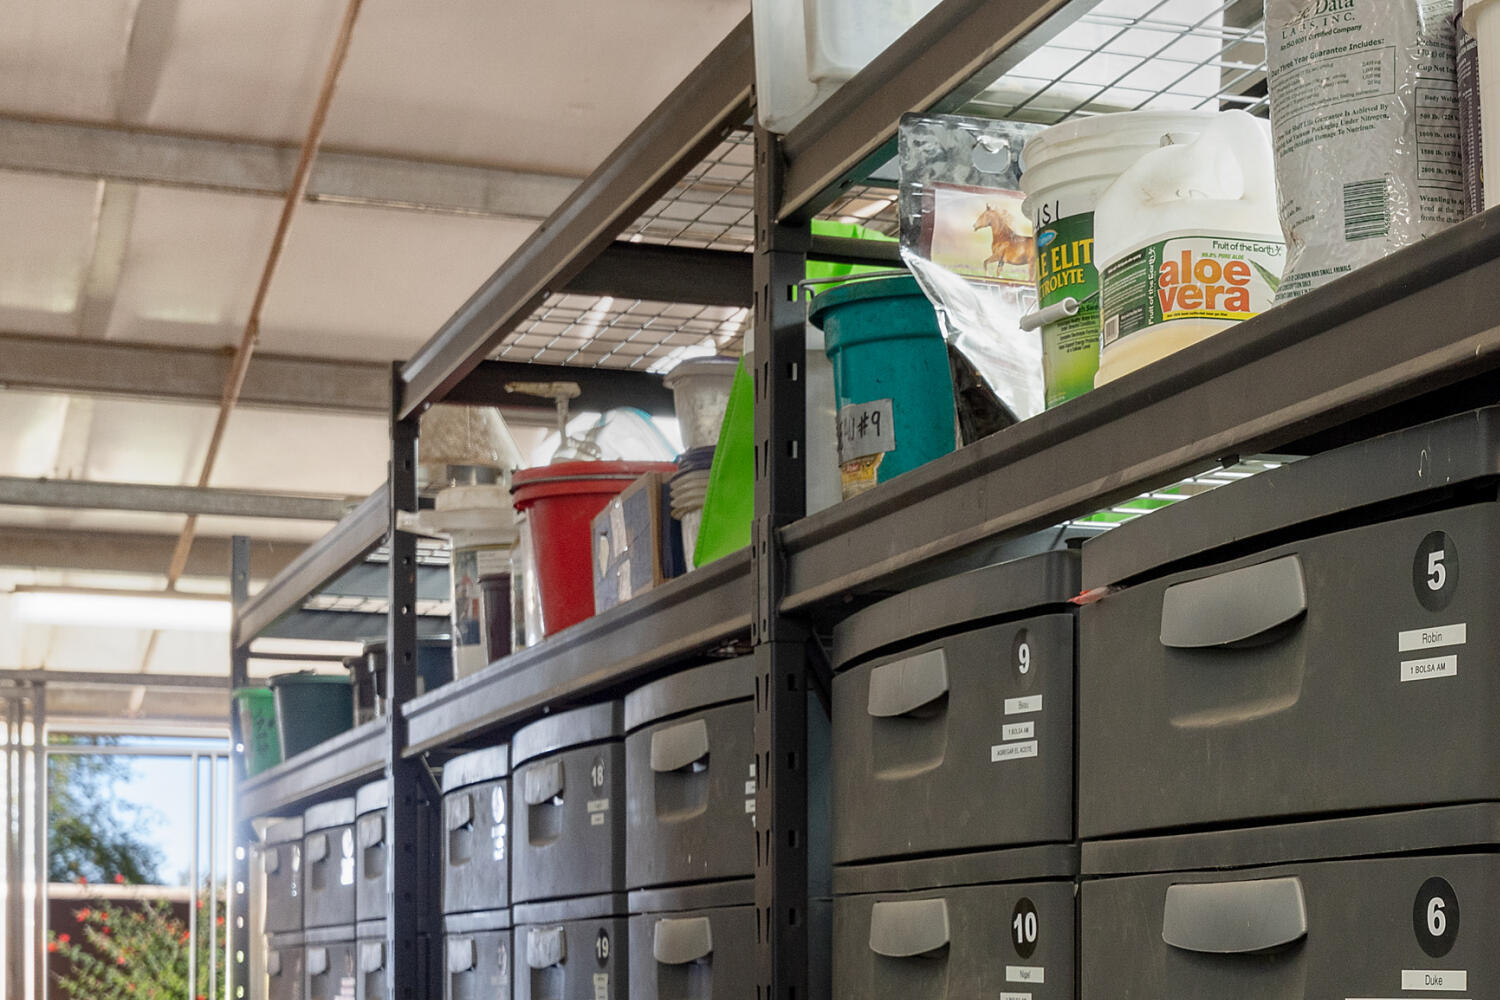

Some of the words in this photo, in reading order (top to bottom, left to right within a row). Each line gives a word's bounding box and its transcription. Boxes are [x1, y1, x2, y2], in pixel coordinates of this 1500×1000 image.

[1333, 24, 1363, 35] Company
[1279, 59, 1294, 72] Three
[1294, 53, 1309, 66] Year
[1309, 44, 1347, 60] Guarantee
[1348, 38, 1385, 51] Includes:
[1417, 63, 1432, 73] Cup
[1212, 240, 1230, 251] Fruit
[1229, 242, 1239, 251] of
[1239, 242, 1253, 252] the
[1253, 244, 1276, 255] Earth
[1158, 249, 1252, 288] aloe
[1157, 284, 1251, 313] vera
[857, 410, 881, 438] #9
[1427, 549, 1447, 591] 5
[1422, 631, 1443, 644] Robin
[1018, 642, 1030, 674] 9
[1415, 663, 1435, 674] BOLSA
[1436, 662, 1446, 671] AM
[591, 764, 605, 788] 18
[1013, 911, 1037, 943] 10
[1427, 896, 1447, 937] 6
[596, 936, 610, 953] 19
[1424, 974, 1444, 986] Duke
